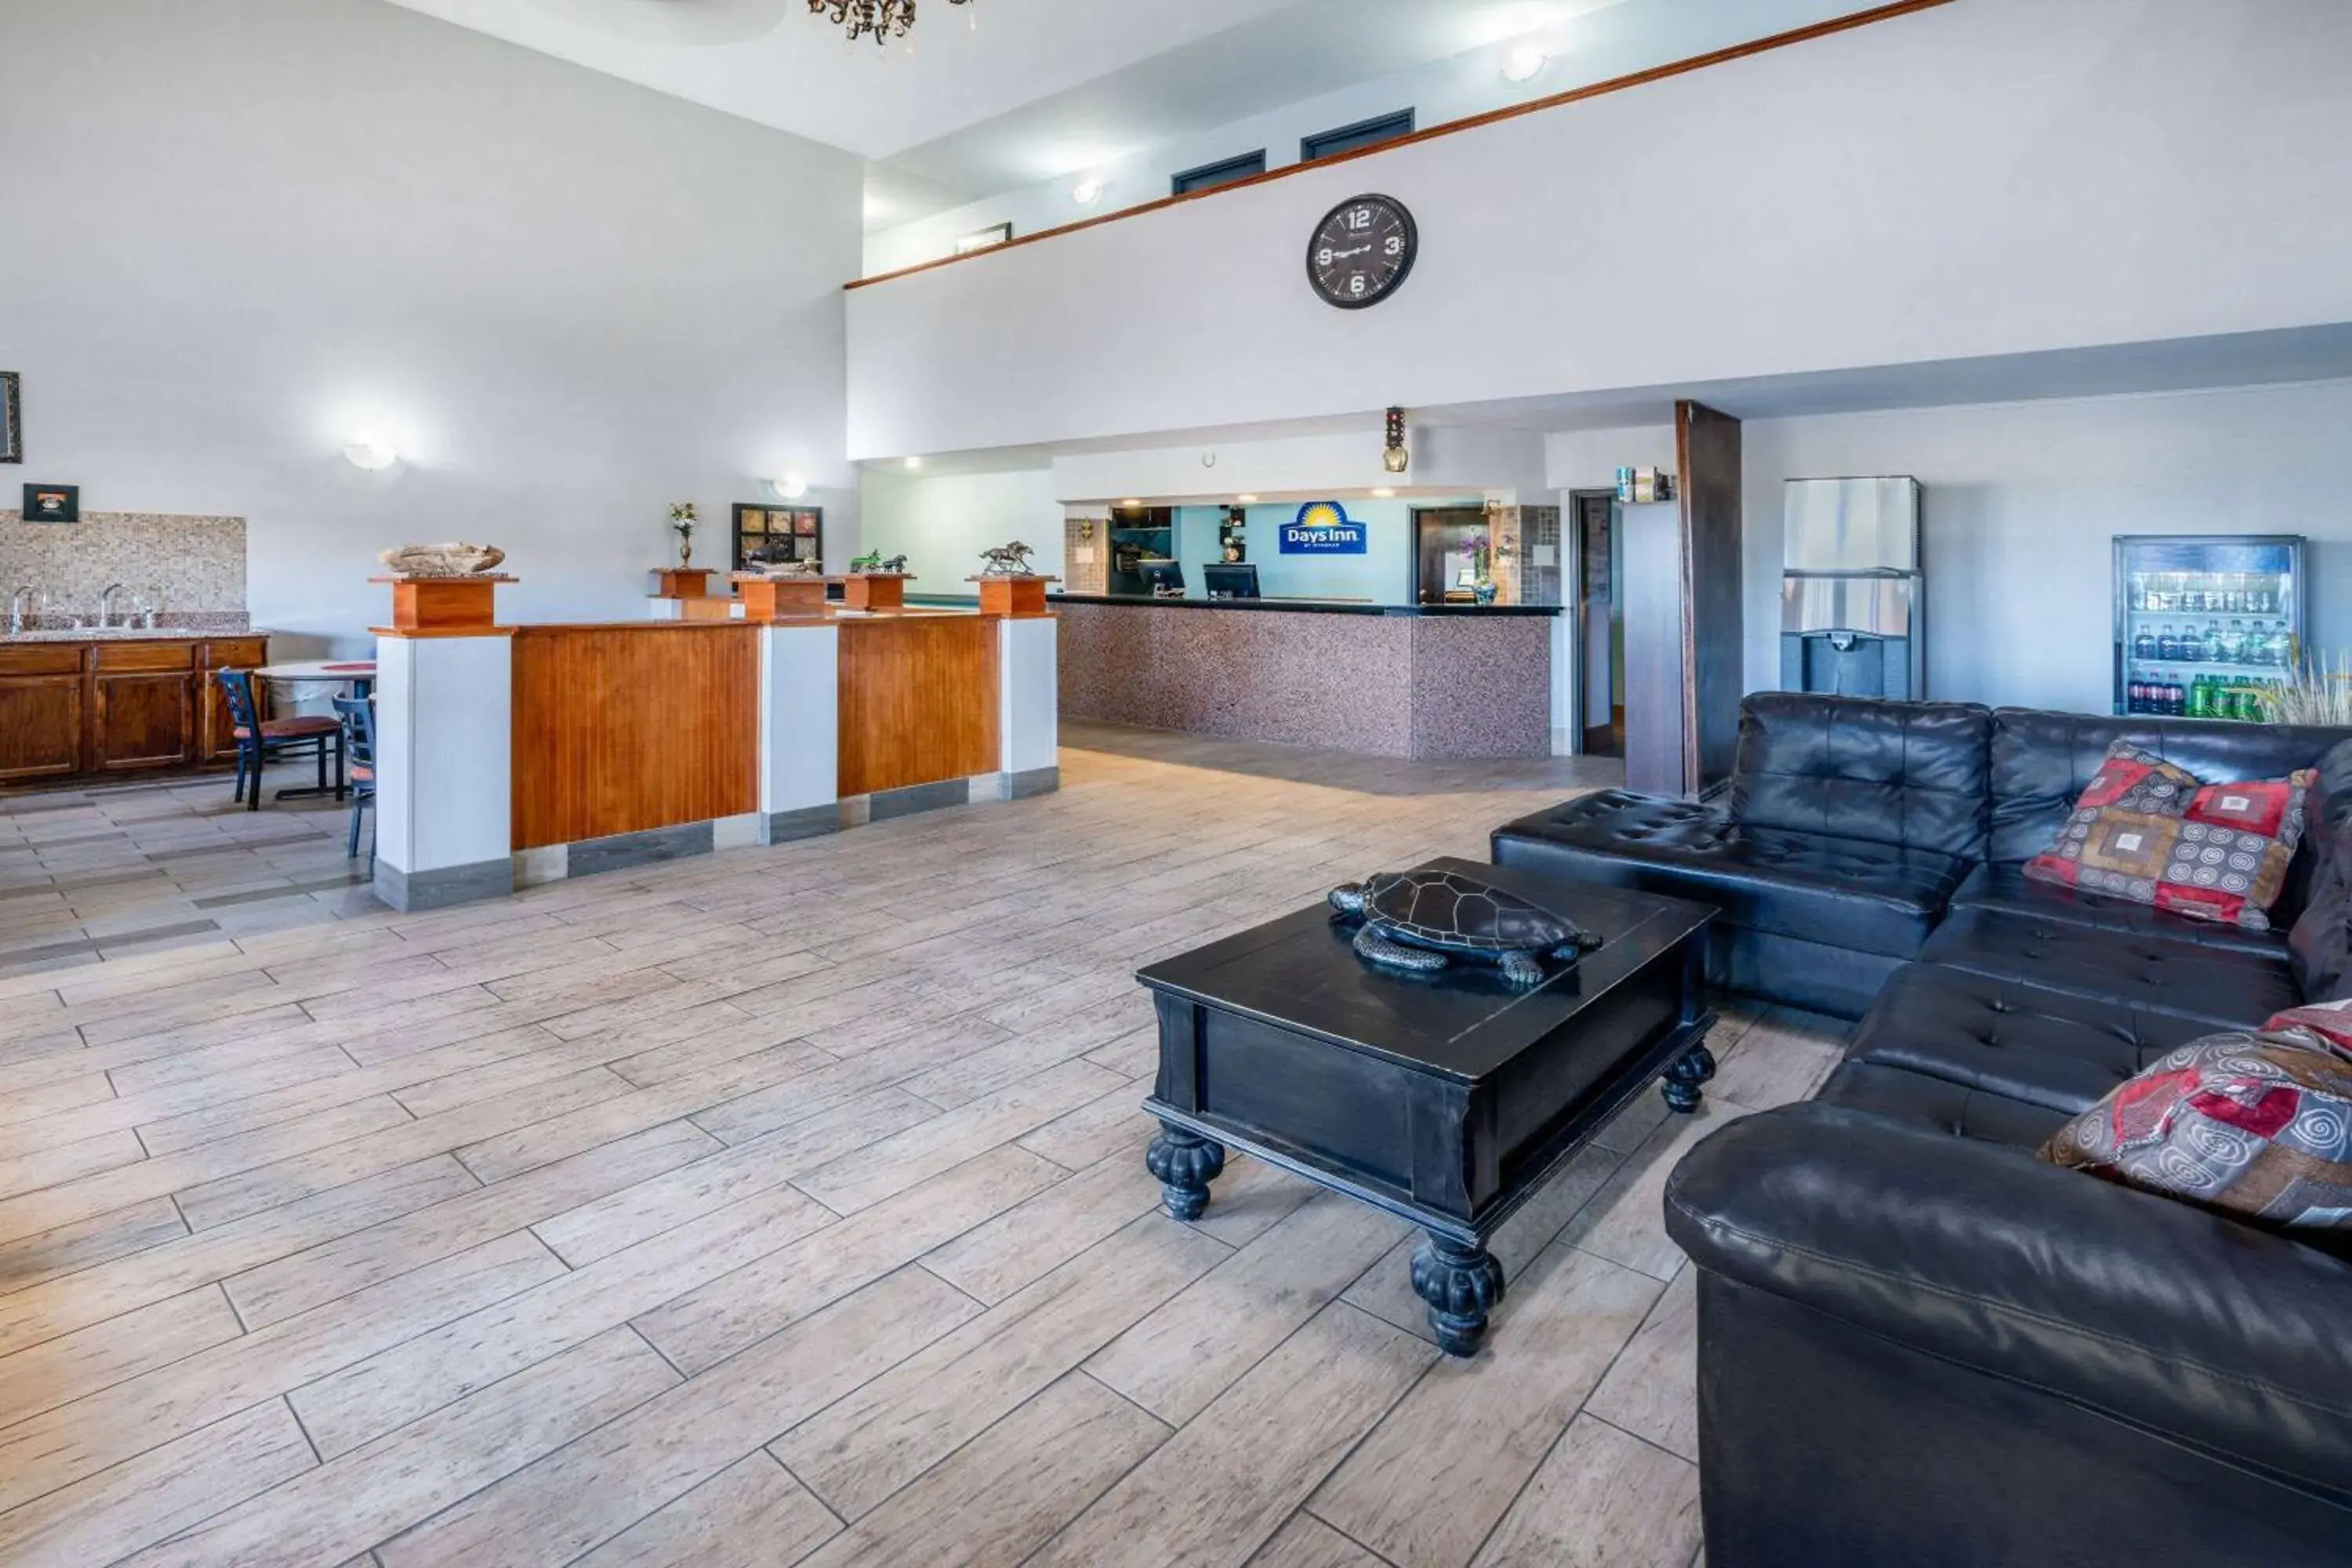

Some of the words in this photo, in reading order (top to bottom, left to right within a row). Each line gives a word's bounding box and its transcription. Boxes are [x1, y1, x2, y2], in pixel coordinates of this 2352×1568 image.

[1348, 209, 1370, 230] 12
[1384, 237, 1400, 255] 3
[1319, 249, 1333, 266] 9
[1350, 275, 1365, 293] 6
[1288, 529, 1327, 543] Days
[1329, 528, 1357, 541] Inn
